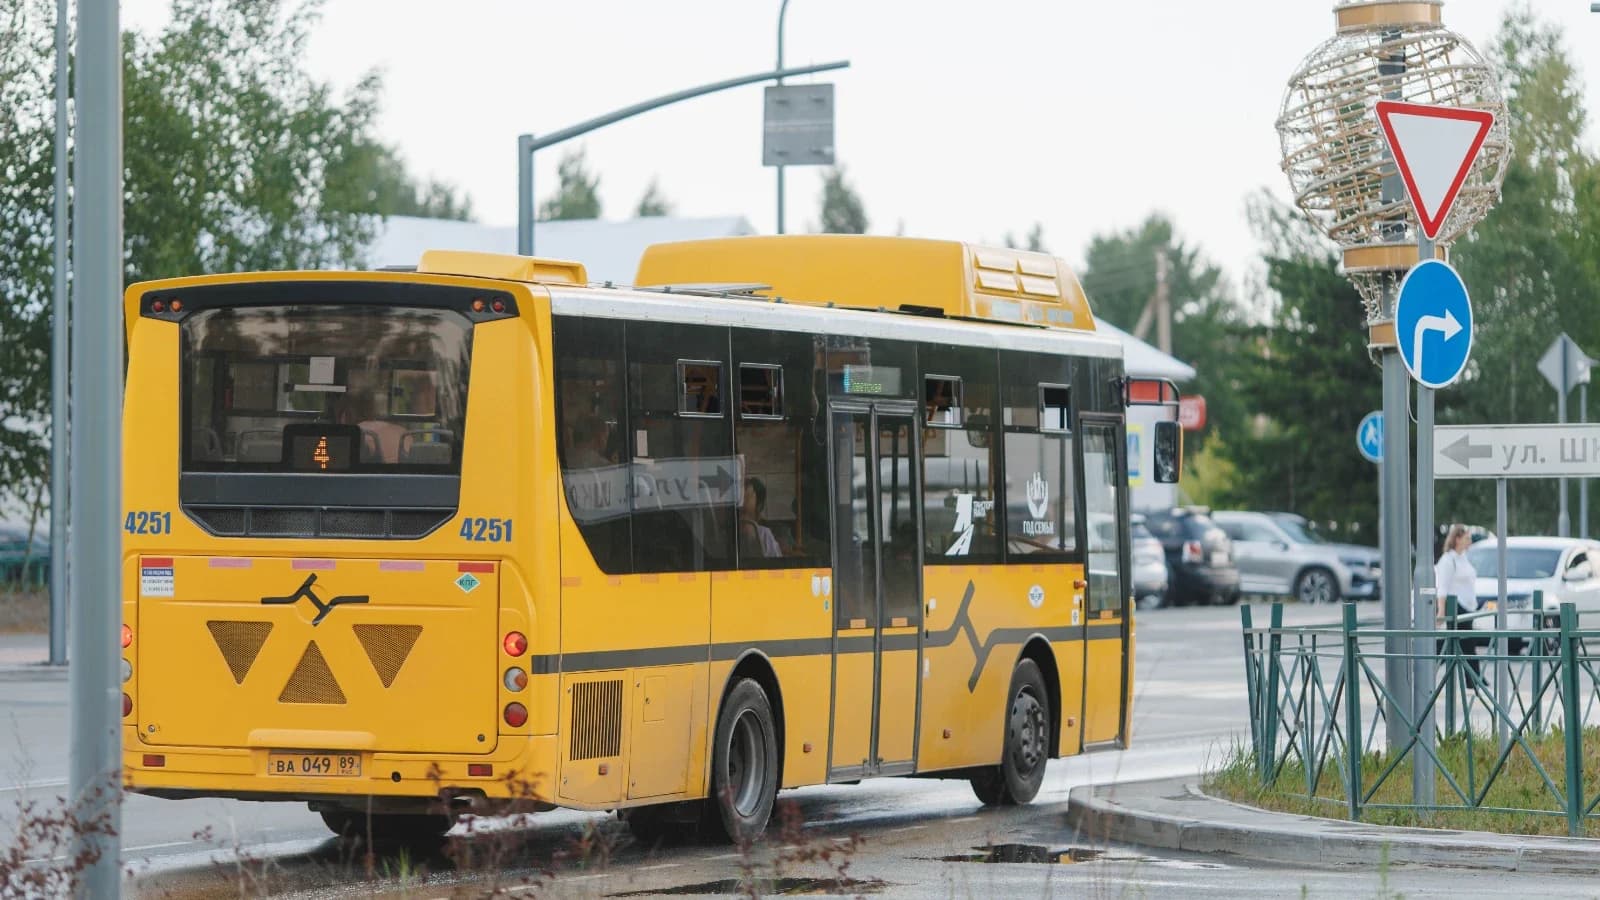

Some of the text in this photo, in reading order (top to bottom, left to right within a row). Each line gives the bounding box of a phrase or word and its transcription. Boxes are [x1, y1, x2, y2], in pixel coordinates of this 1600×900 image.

[314, 436, 330, 470] 4
[1502, 444, 1546, 471] ул.
[124, 511, 171, 535] 4251
[459, 517, 513, 542] 4251
[276, 757, 355, 773] ВА 049 89
